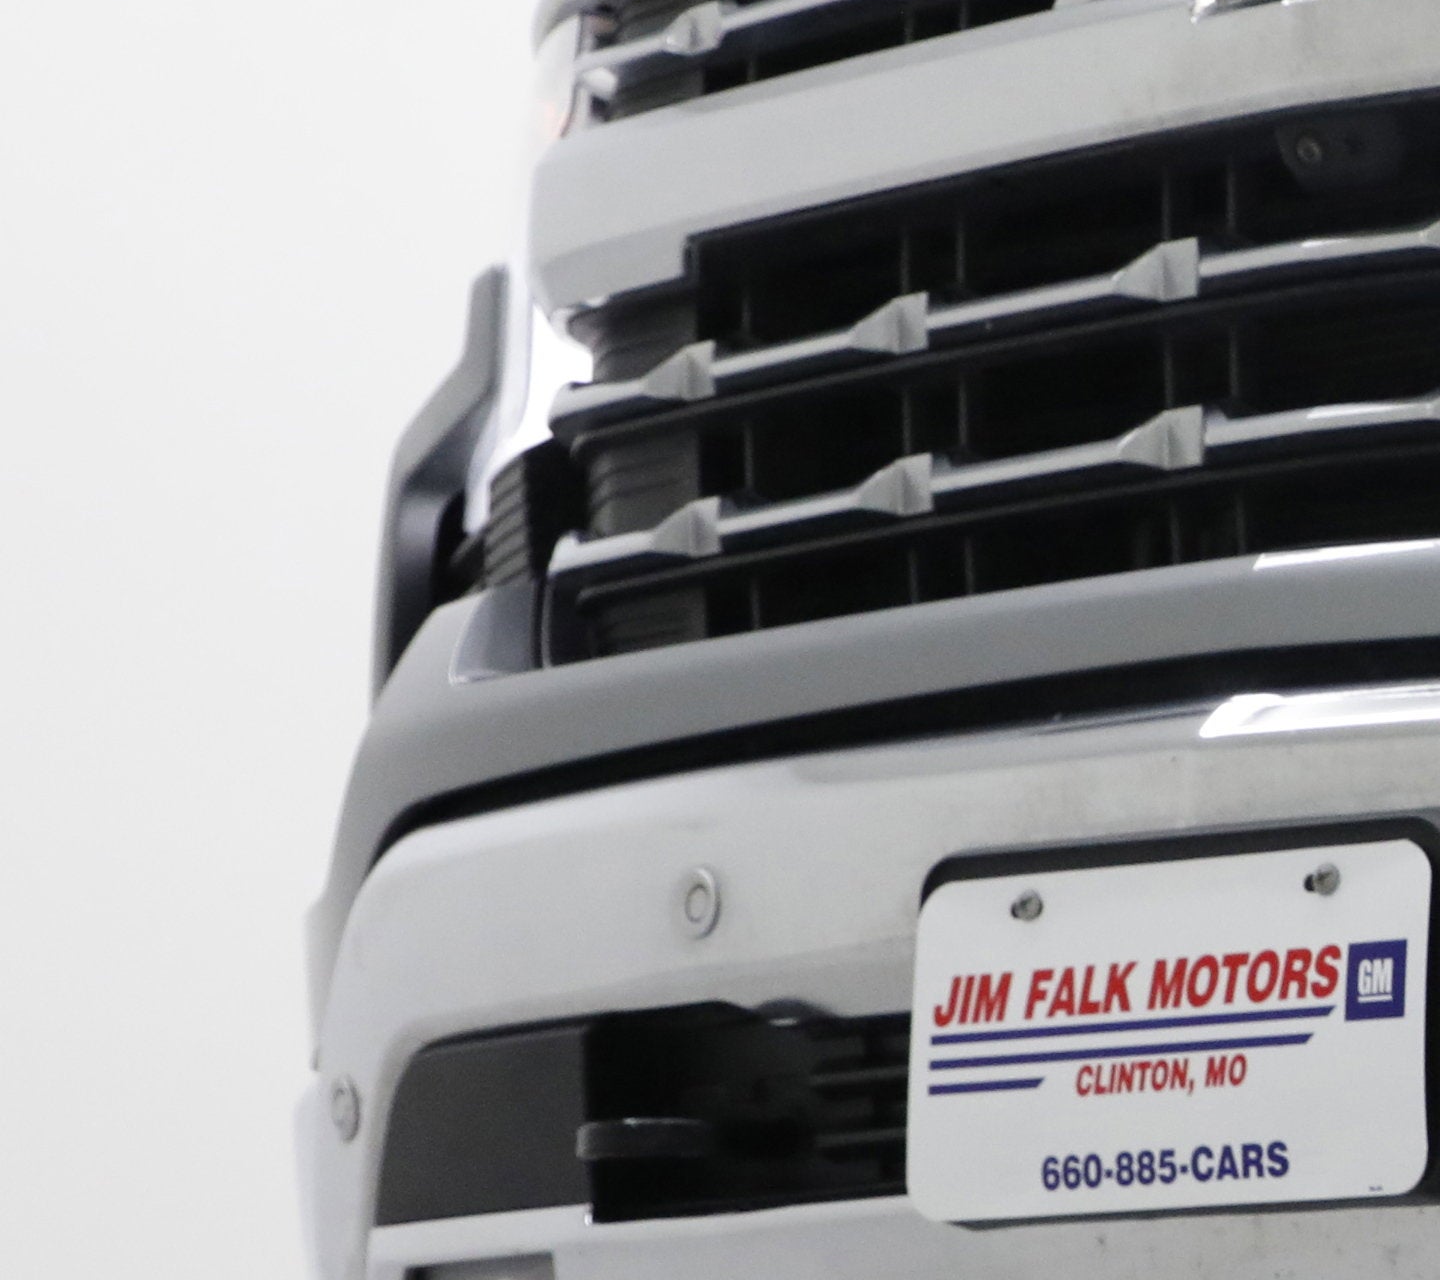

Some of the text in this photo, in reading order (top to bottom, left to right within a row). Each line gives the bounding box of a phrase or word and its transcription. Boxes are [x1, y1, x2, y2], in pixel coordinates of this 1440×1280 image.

[932, 944, 1342, 1027] JIM FALK MOTORS
[1357, 957, 1394, 998] GM
[1075, 1053, 1247, 1096] CLINTON, MO
[1041, 1141, 1290, 1190] 660-885-CARS
